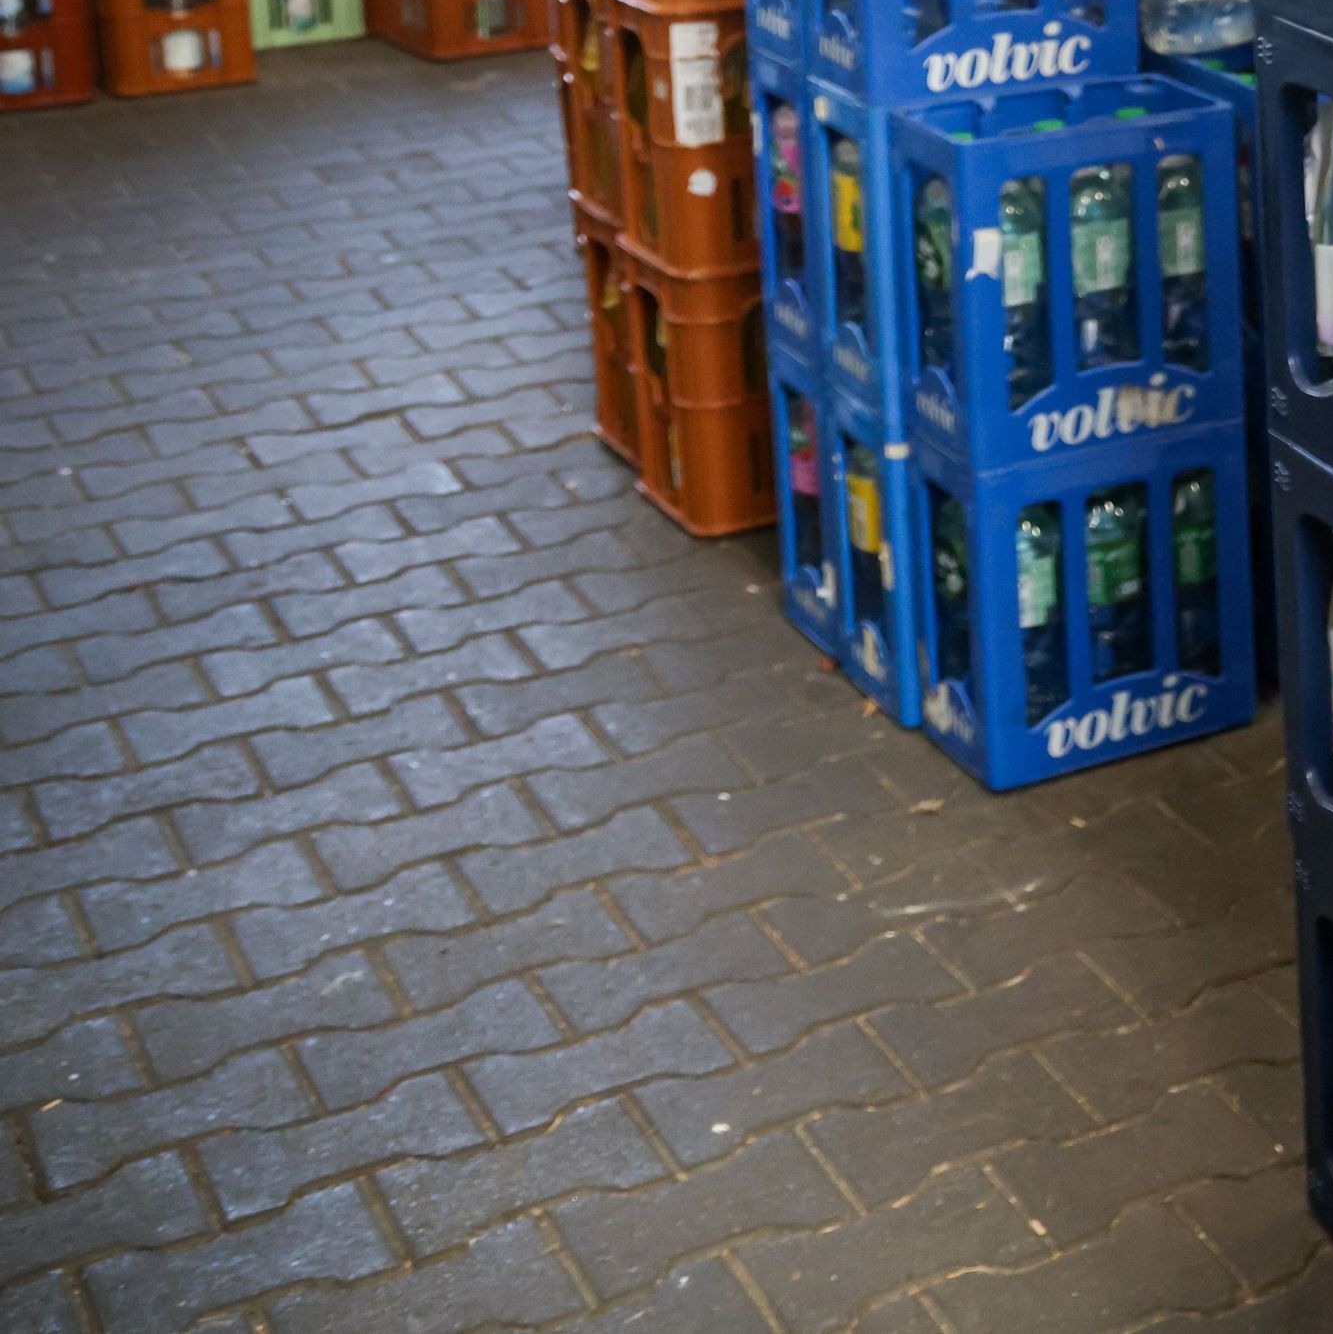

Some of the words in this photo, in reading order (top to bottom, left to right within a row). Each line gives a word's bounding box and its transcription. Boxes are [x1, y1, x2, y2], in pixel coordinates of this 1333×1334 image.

[923, 21, 1092, 93] volvic
[1028, 372, 1197, 453] volvic
[1043, 673, 1210, 760] volvic
